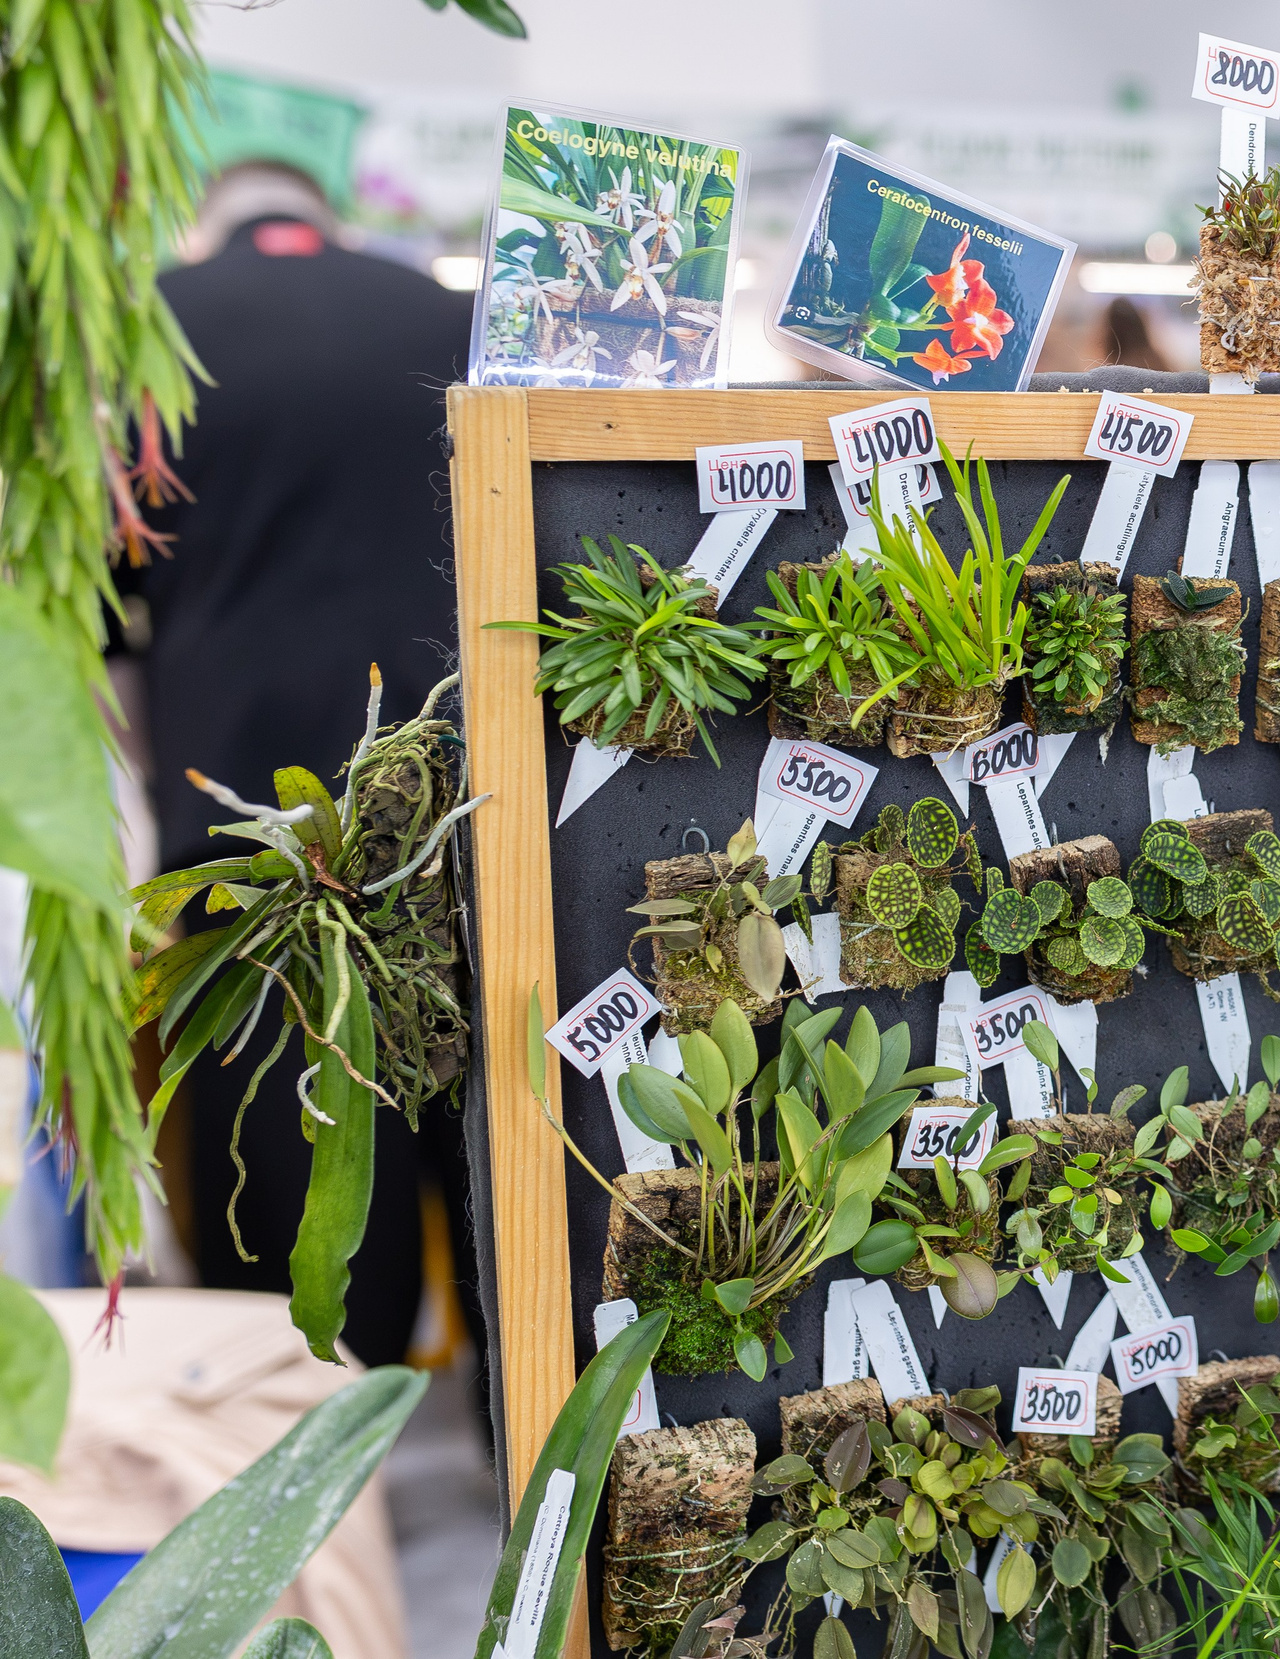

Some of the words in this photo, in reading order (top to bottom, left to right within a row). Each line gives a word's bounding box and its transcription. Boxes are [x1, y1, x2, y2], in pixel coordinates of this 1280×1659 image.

[1211, 51, 1275, 94] 8000
[516, 118, 640, 162] Coelogyne
[645, 147, 734, 178] velutina
[866, 178, 971, 236] Ceratocentron
[970, 222, 1024, 257] fesselii
[851, 409, 933, 468] 4000
[1101, 413, 1173, 456] 4500
[709, 459, 748, 472] Цена
[718, 460, 792, 501] 4000
[1132, 472, 1153, 511] latystele
[1115, 513, 1138, 562] acutilingua
[1218, 501, 1235, 557] Angraecum
[972, 729, 1039, 781] 6000
[781, 755, 851, 803] 5500
[1017, 782, 1036, 830] Lepanthes
[790, 813, 816, 854] epanthes
[566, 991, 638, 1062] 5000
[1130, 1332, 1181, 1375] 5000
[1020, 1385, 1082, 1423] 3500
[550, 1505, 566, 1549] Cattleya
[540, 1551, 554, 1587] Roque
[530, 1590, 544, 1626] Sevilla
